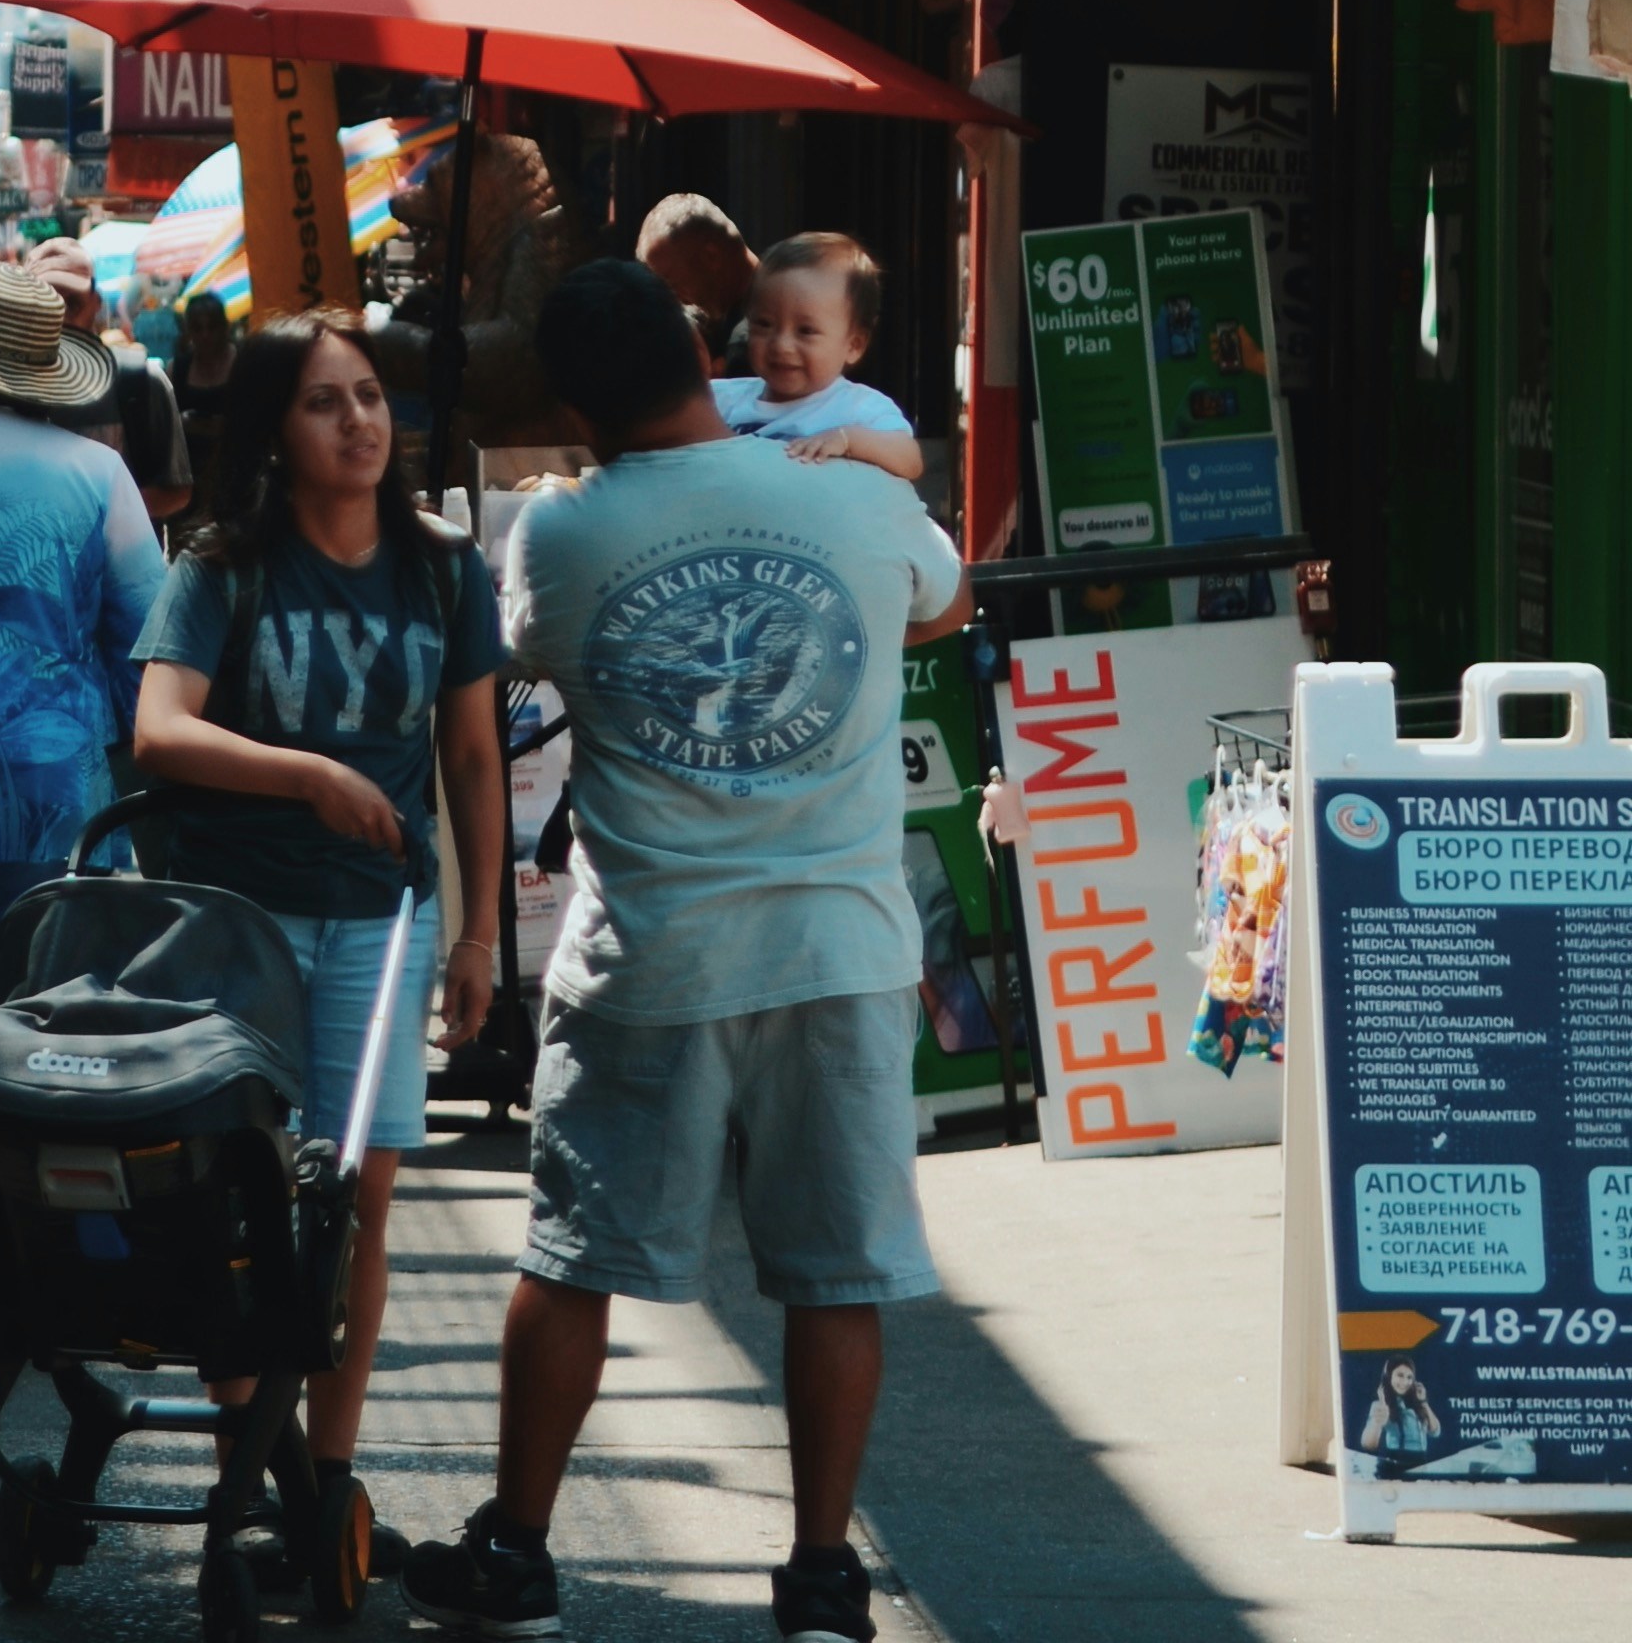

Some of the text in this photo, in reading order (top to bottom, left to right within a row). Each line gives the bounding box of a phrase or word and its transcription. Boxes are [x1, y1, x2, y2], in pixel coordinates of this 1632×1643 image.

[15, 60, 66, 77] Beauty
[13, 75, 66, 94] Supply
[1152, 142, 1280, 175] COMMERCIAL
[1220, 175, 1270, 194] ESTATE
[1168, 231, 1226, 248] Your new
[1155, 246, 1243, 270] phone is here
[1034, 302, 1140, 332] Unlimited
[1064, 334, 1112, 356] Plan
[1177, 485, 1272, 505] Ready to make
[1179, 508, 1199, 522] the
[1229, 501, 1274, 521] yours?
[1064, 521, 1085, 534] You
[1087, 518, 1135, 533] deserve
[601, 555, 841, 641] WATKINS GLEN
[635, 699, 834, 767] STATE PARK
[1397, 796, 1608, 827] TRANSLATION
[1415, 837, 1504, 860] БЮРО
[1414, 869, 1502, 891] БЮРО
[1010, 649, 1177, 1145] PERFUME
[1350, 907, 1498, 920] BUSINESS TRANSLATION
[1351, 923, 1478, 935] LEGAL TRANSLATION
[1352, 938, 1496, 951] MEDICAL TRANSLATION
[1353, 954, 1512, 966] TECHNICAL TRANSLATION
[1353, 969, 1480, 982] BOOK TRANSLATION
[1354, 985, 1504, 997] PERSONAL DOCUMENTS
[1355, 1000, 1444, 1013] INTERPRETING
[1355, 1016, 1515, 1029] APOSTILLE/LEGALIZATION
[1356, 1031, 1547, 1046] AUDIO/VIDEO TRANSCRIPTION
[1357, 1047, 1474, 1059] CLOSED CAPTIONS
[27, 1047, 110, 1076] doona
[1357, 1062, 1480, 1075] FOREIGN SUBTITLES
[1358, 1078, 1488, 1090] WE TRANSLATE OVER
[1359, 1093, 1438, 1106] LANGUAGES
[1359, 1109, 1537, 1123] HIGH QUALITY GUARANTEED
[1574, 1107, 1594, 1118] МЫ
[1575, 1122, 1623, 1134] ЯЗЫКОВ
[1365, 1172, 1527, 1195] АПОСТИЛЬ
[1378, 1201, 1522, 1219] ДОВЕРЕННОСТЬ
[1379, 1221, 1488, 1236] ЗАЯВЛЕНИЕ
[1380, 1241, 1510, 1256] СОГЛАСИЕ НА
[1381, 1260, 1528, 1278] ВЫЕЗД РЕБЕНКА
[1449, 1398, 1614, 1410] THE BEST SERVICES FOR
[1460, 1409, 1606, 1426] ЛУЧШИЙ СЕРВИС ЗА
[1541, 1427, 1609, 1440] ПОСЛУГИ
[1611, 1427, 1631, 1440] ЗА
[1570, 1443, 1606, 1457] ЦІНУ
